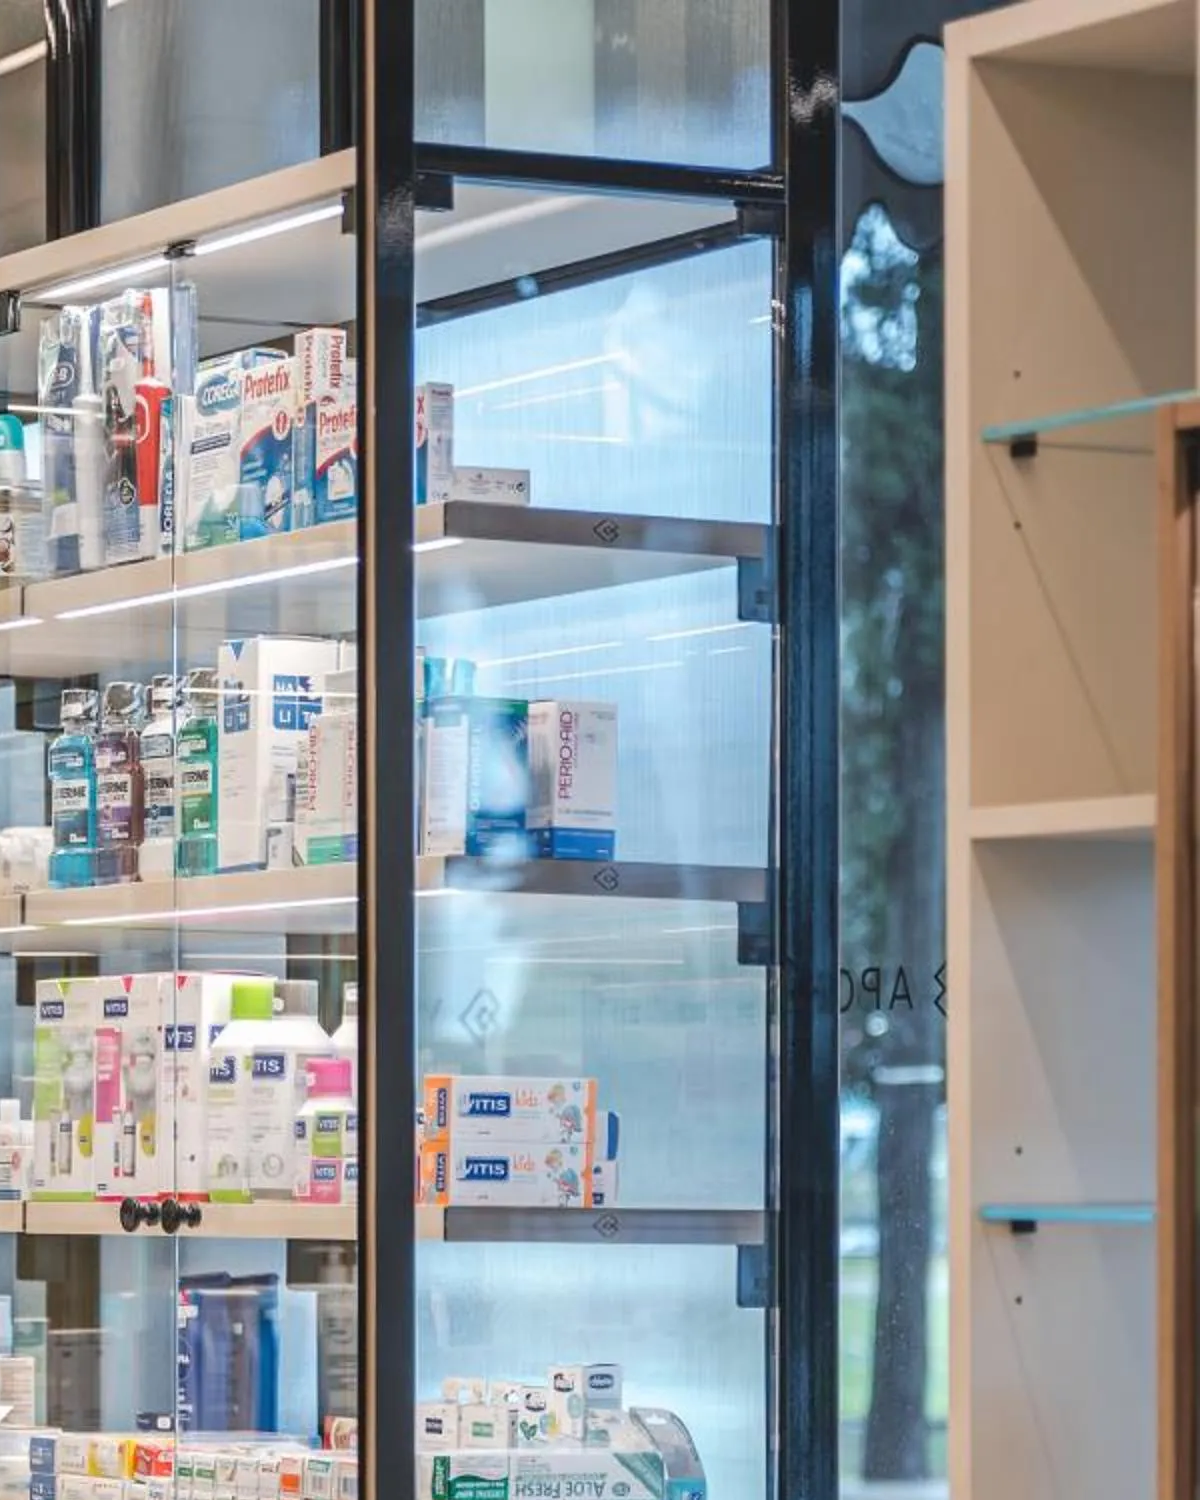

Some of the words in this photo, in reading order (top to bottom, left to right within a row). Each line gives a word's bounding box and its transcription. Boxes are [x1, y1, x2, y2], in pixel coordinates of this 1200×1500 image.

[245, 365, 291, 399] Protefix
[255, 1059, 280, 1073] TIS
[466, 1096, 508, 1113] VITIS
[464, 1161, 506, 1177] VITIS
[514, 1482, 561, 1498] FRESH
[565, 1481, 606, 1497] ALOE
